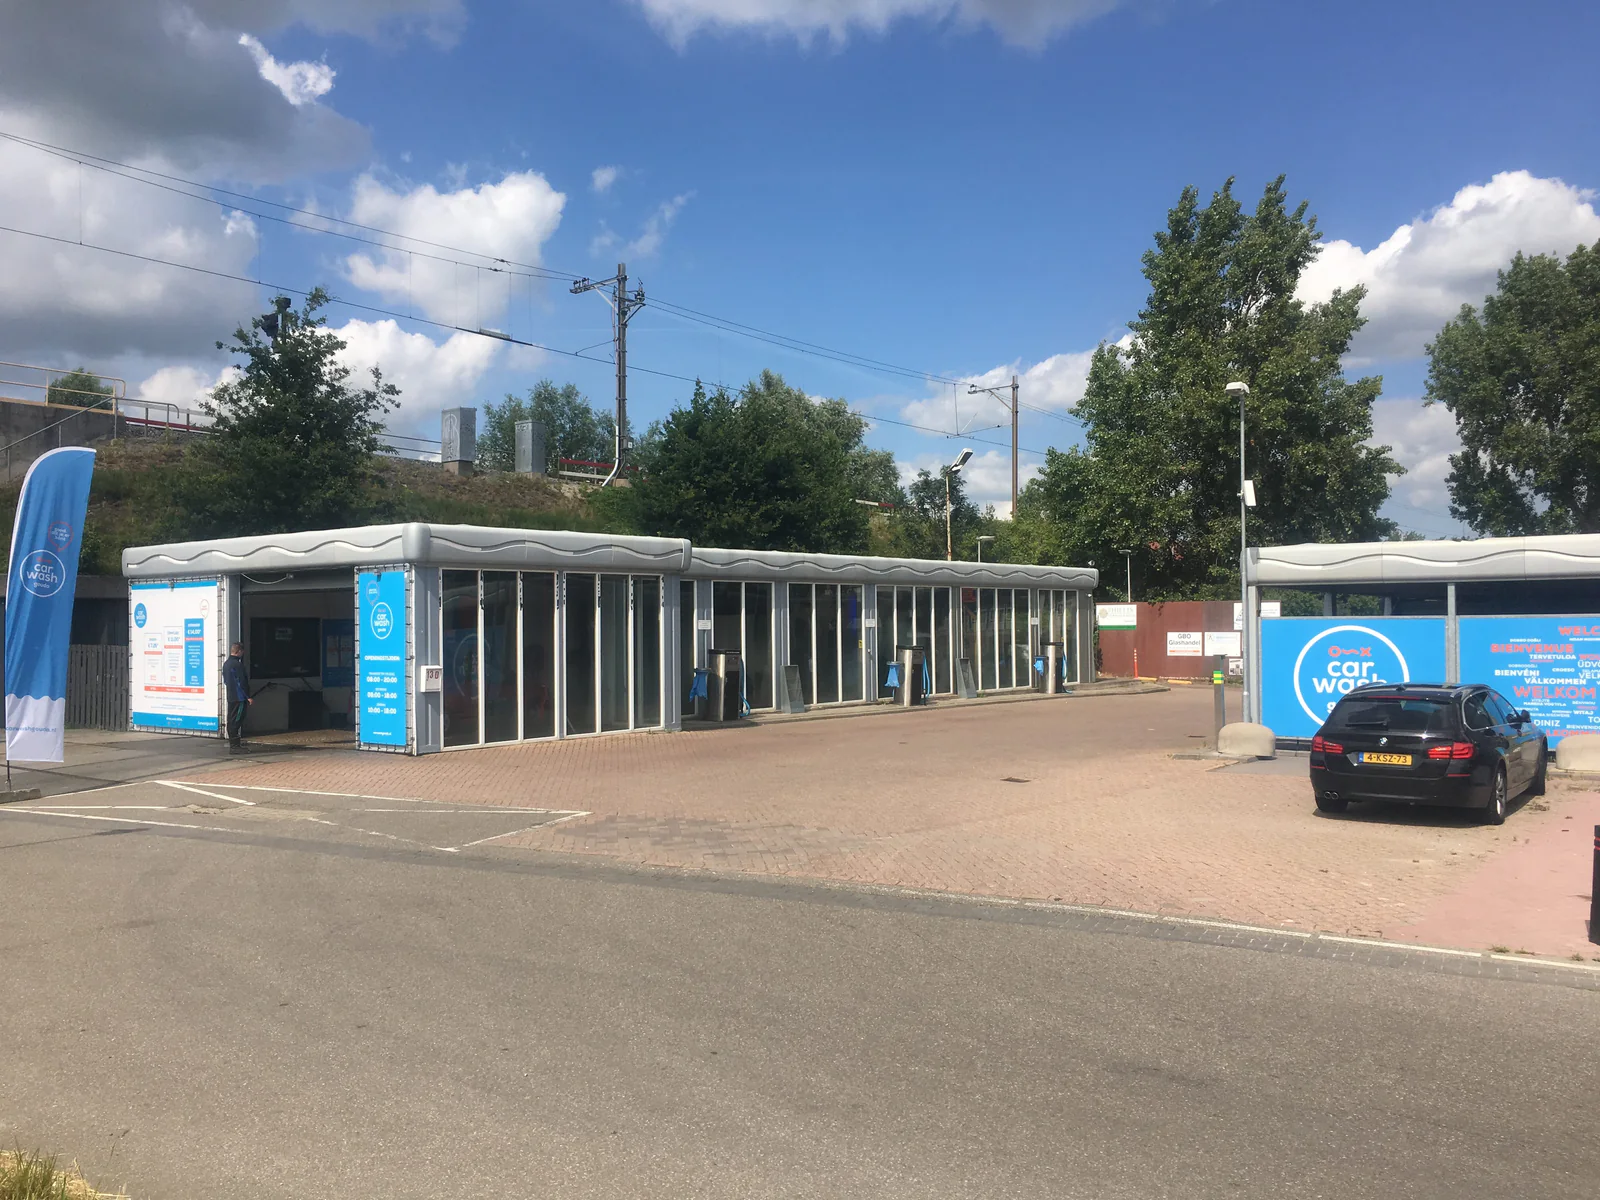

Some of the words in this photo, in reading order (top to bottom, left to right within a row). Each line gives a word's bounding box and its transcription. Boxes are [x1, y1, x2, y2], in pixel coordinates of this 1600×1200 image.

[33, 563, 54, 574] car
[26, 571, 58, 584] wash
[373, 618, 390, 627] wash
[1490, 643, 1574, 653] BIENVENUE
[1327, 660, 1375, 678] car
[1494, 668, 1540, 677] BIENVÉNI
[1524, 676, 1587, 685] VÄLKOMMEN
[1513, 685, 1596, 699] WELKOM
[1367, 753, 1408, 764] 4-KSZ-73
